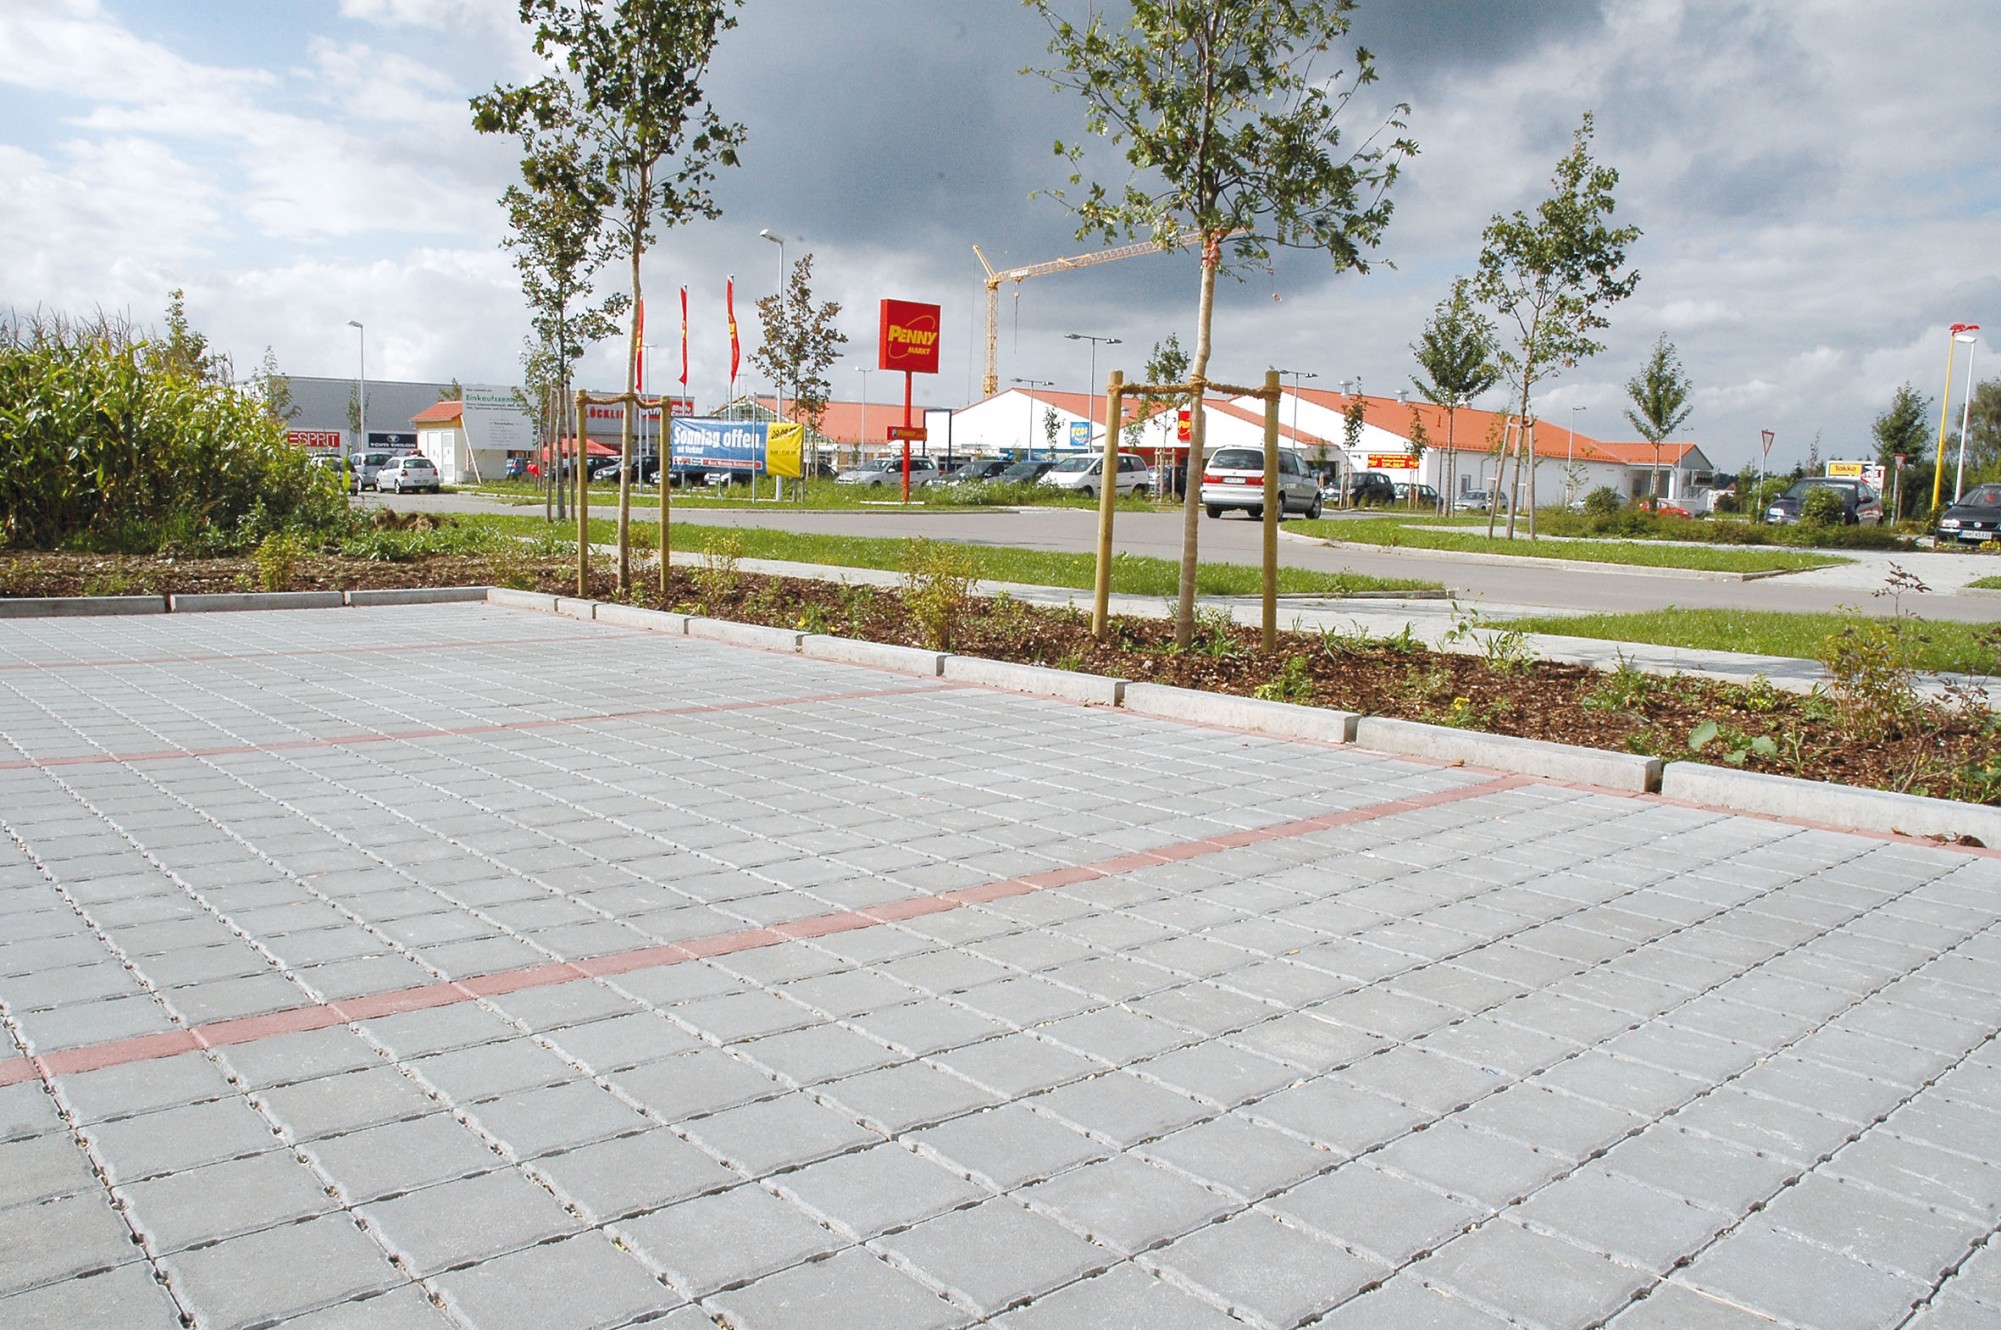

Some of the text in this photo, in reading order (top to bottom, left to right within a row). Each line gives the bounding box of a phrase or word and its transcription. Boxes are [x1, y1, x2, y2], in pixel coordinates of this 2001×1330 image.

[888, 325, 937, 345] PENNY
[908, 346, 931, 355] MARKT
[288, 432, 338, 446] ESPRIT
[674, 426, 760, 448] Sonntag offen
